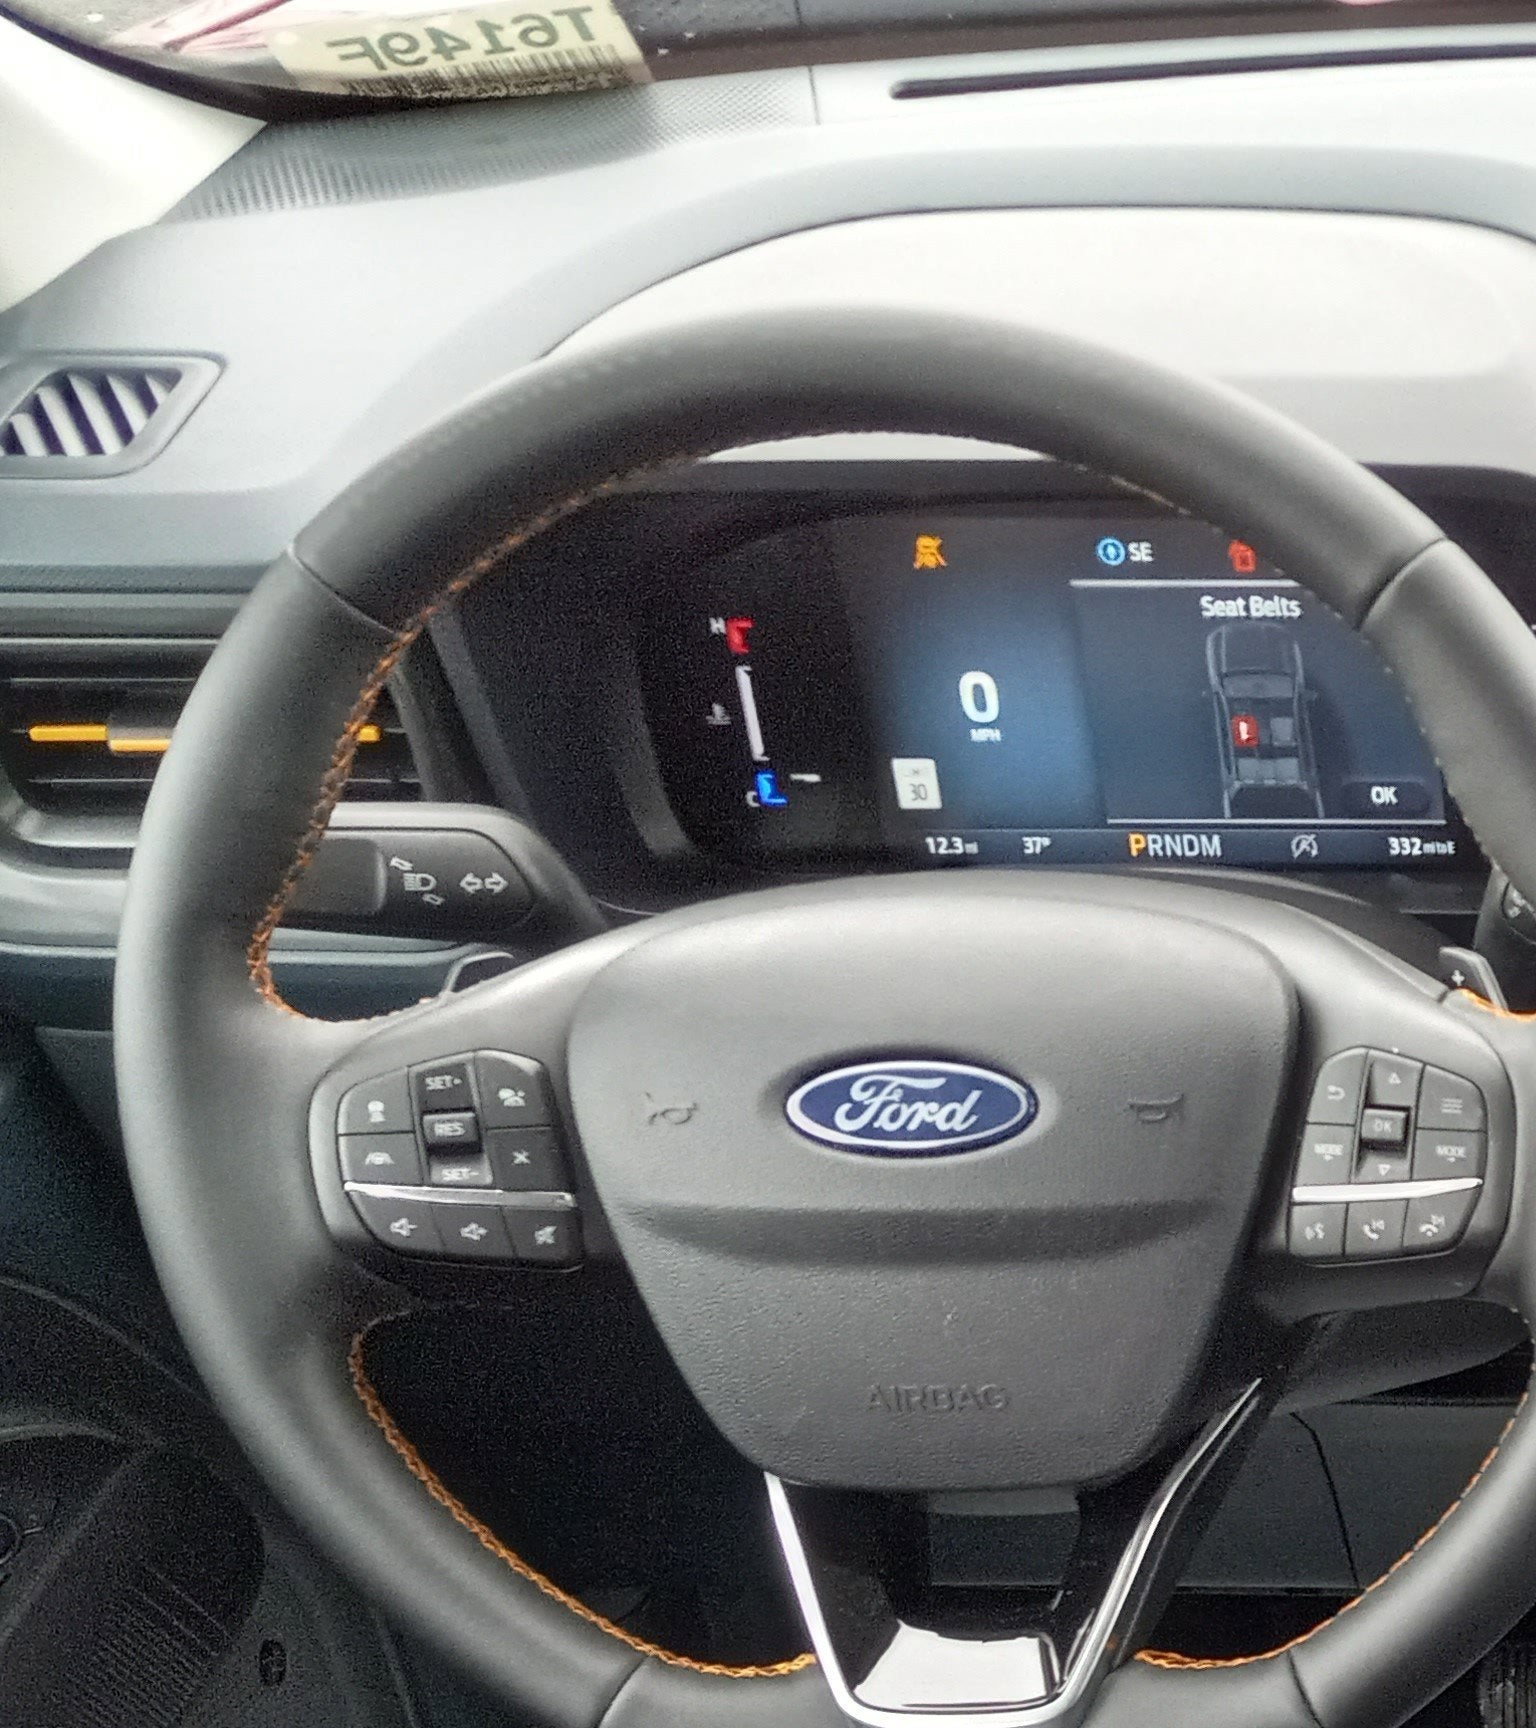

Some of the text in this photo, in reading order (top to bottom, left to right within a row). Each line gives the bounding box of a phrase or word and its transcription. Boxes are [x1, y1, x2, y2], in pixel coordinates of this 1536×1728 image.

[1128, 541, 1155, 563] SE
[1201, 595, 1302, 618] Seat Belts
[959, 669, 1000, 723] 0
[1370, 786, 1399, 805] OK
[833, 1074, 984, 1133] Ford
[1372, 1119, 1392, 1133] OK
